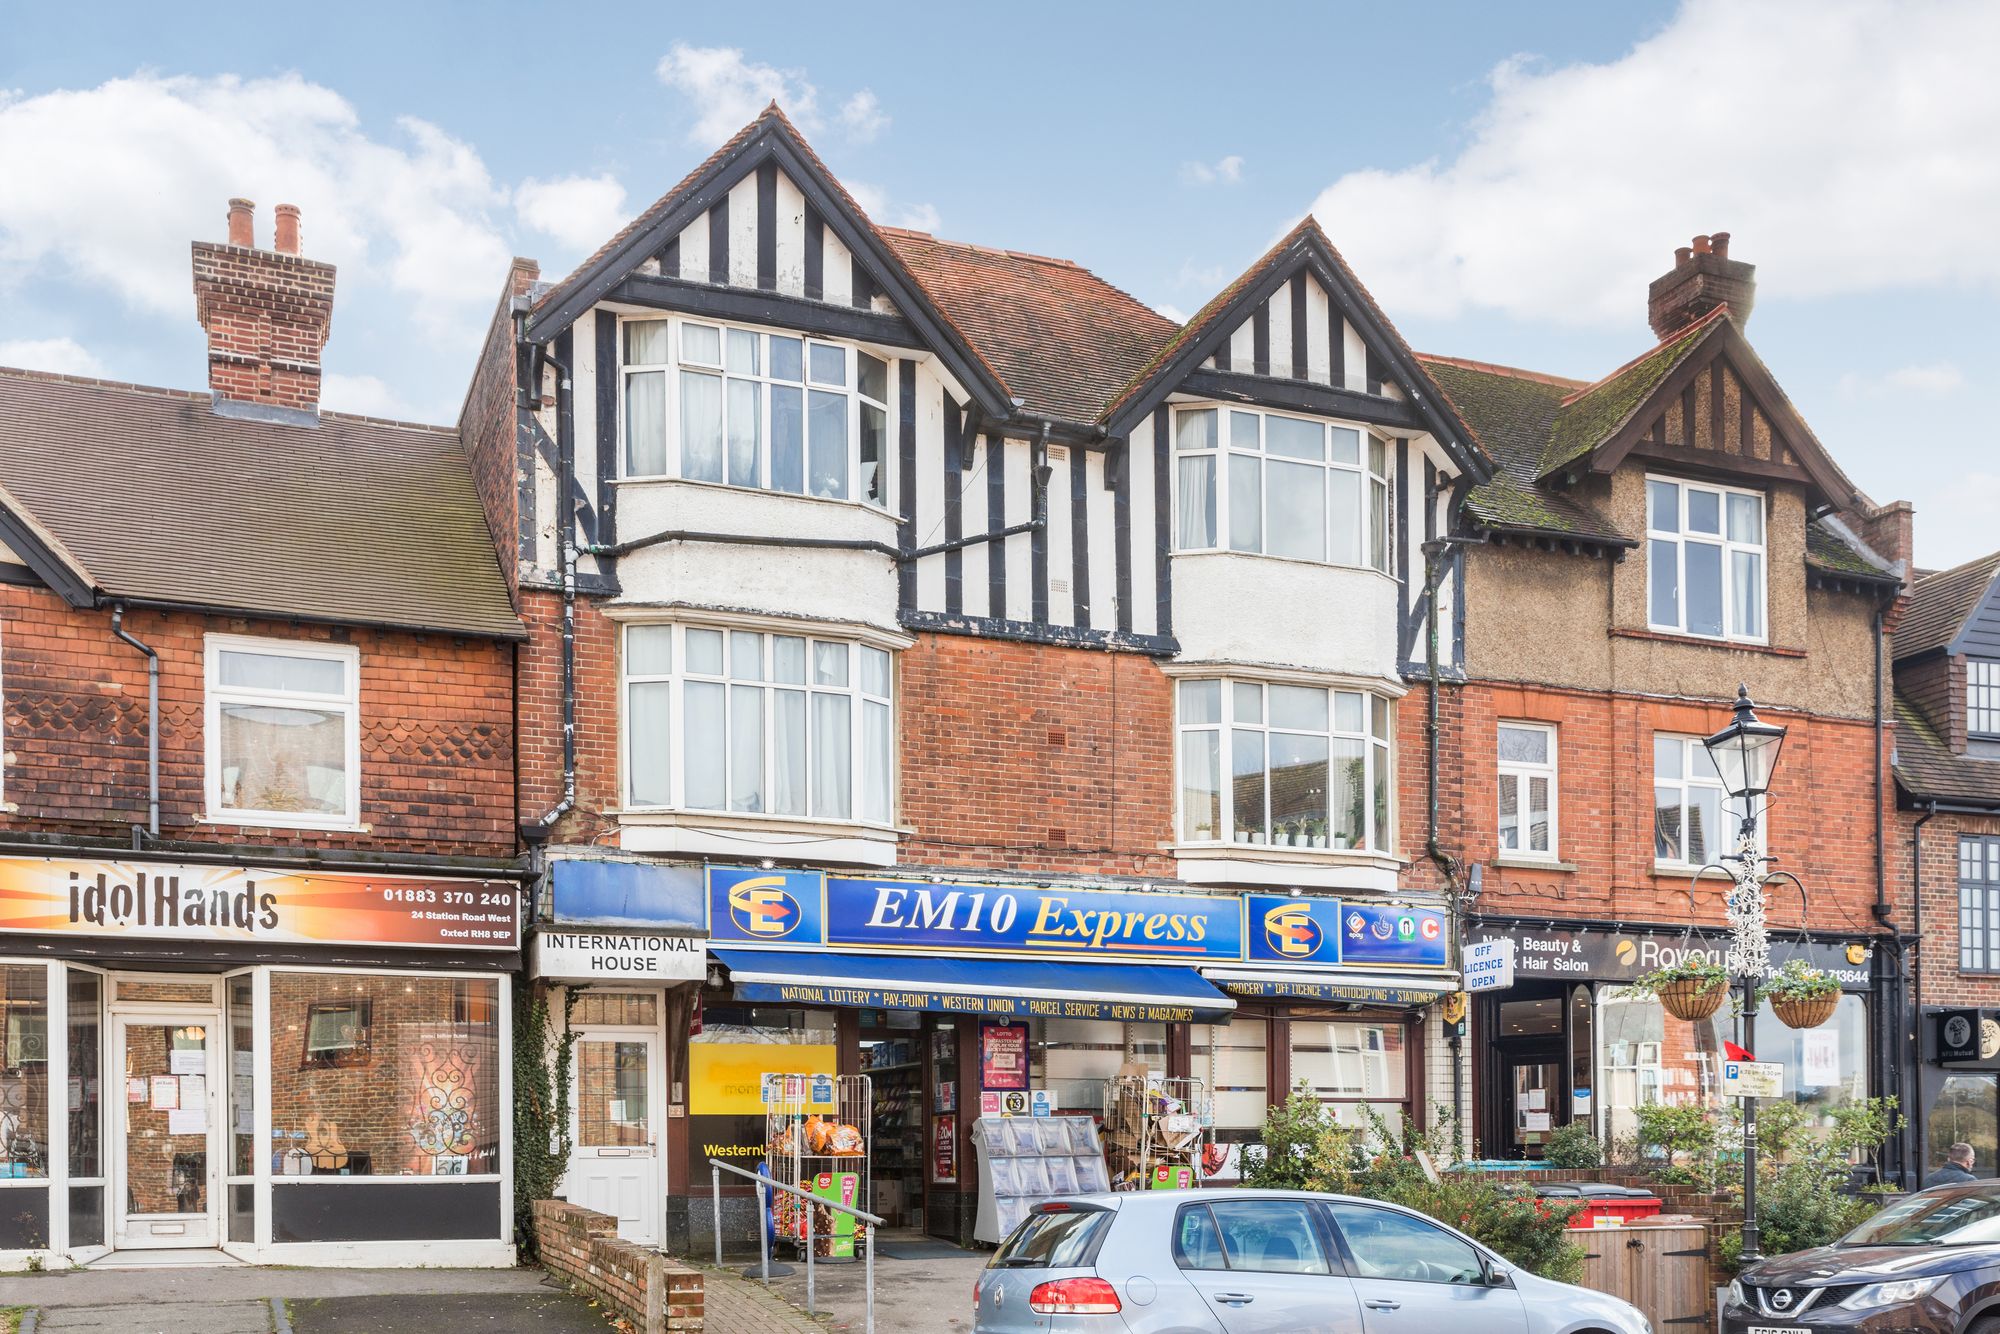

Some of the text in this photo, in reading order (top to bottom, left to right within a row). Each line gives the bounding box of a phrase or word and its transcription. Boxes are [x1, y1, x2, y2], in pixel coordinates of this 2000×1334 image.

[384, 889, 511, 906] 01883 370 240
[411, 911, 511, 923] 24 Station Road West
[864, 887, 1208, 947] EM10 Express
[440, 929, 511, 939] Oxted RH8 9EP
[546, 934, 700, 953] INTERNATIONAL
[1475, 945, 1492, 957] OFF
[1523, 936, 1569, 955] Beauty
[1572, 939, 1582, 953] &
[591, 956, 657, 972] HOUSE
[1464, 958, 1503, 974] LICENCE
[1523, 956, 1549, 970] Hair
[1553, 957, 1589, 972] Salon
[1472, 975, 1496, 988] OPEN
[1828, 969, 1869, 983] 713644
[1227, 982, 1439, 1003] GROCERY OFF LICENCE PHOTOCOPYING STATIONERY
[781, 987, 1194, 1022] NATIONAL LOTTERY PAY-POINT WESTERN UNION PARCEL SERVICE NEWS & MAGAZINES
[1729, 1067, 1737, 1078] P
[704, 1144, 767, 1157] WesternU
